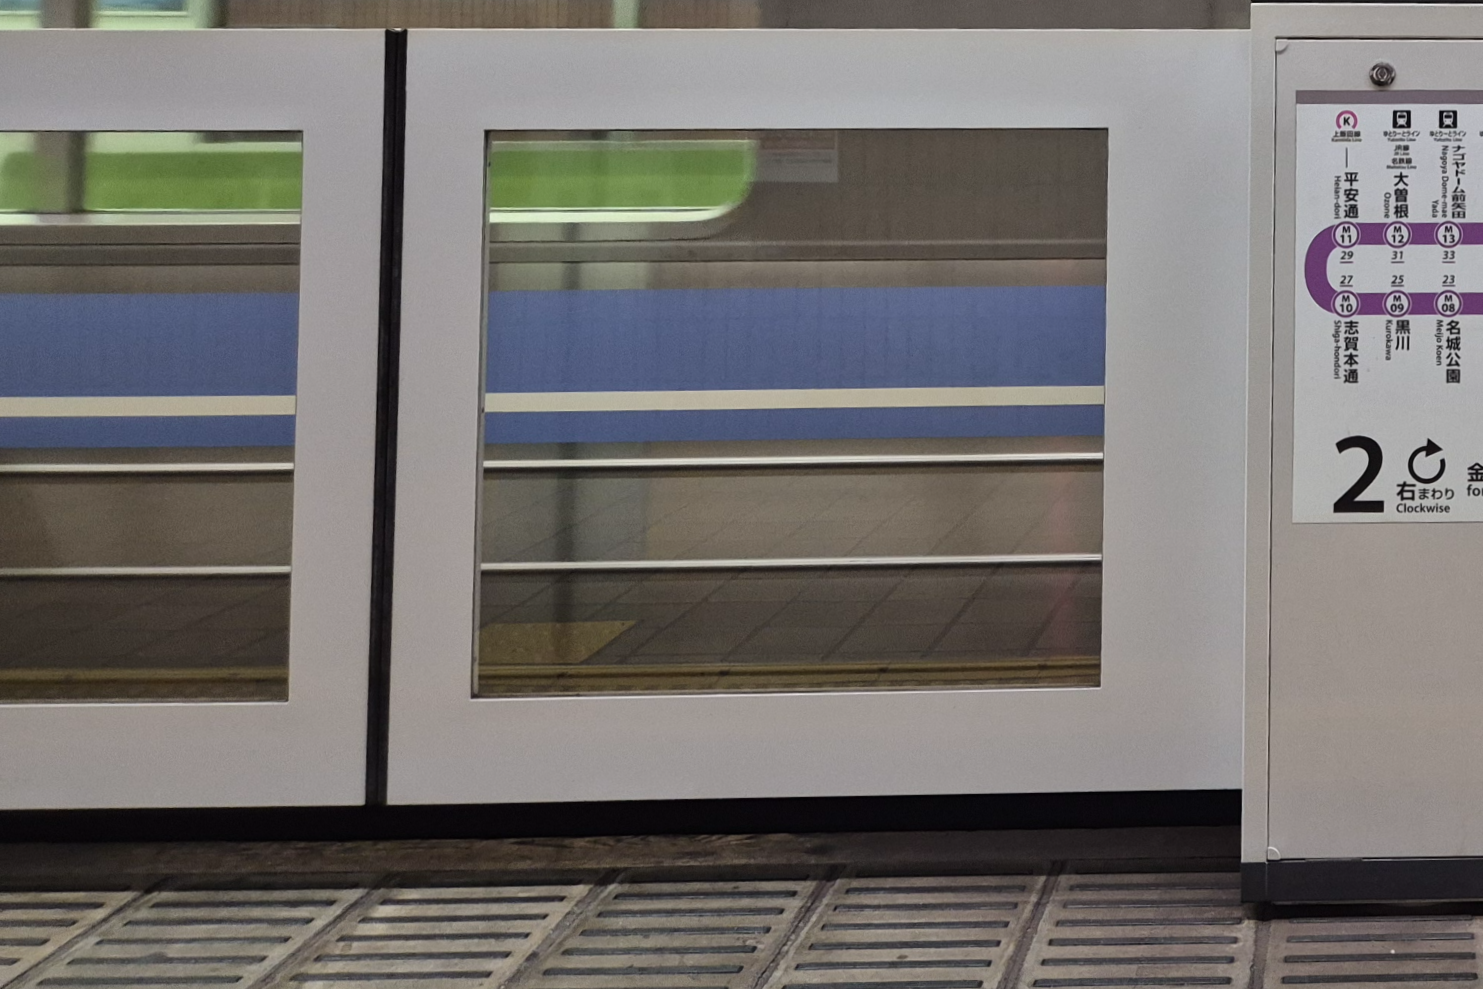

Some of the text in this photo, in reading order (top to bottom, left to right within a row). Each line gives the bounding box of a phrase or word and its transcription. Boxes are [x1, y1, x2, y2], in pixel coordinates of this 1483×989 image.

[1343, 116, 1350, 126] K
[1440, 145, 1449, 174] Nagoya
[1452, 145, 1466, 219] ナゴヤドーム前矢田
[1344, 172, 1359, 219] 平安通
[1394, 172, 1409, 219] 大曽根
[1340, 251, 1353, 260] 29
[1391, 251, 1404, 260] 31
[1442, 251, 1456, 260] 33
[1340, 275, 1353, 284] 27
[1391, 275, 1404, 284] 25
[1442, 275, 1455, 284] 23
[1395, 320, 1410, 351] 黒川
[1434, 320, 1443, 343] Meijo
[1332, 320, 1341, 379] Shiga-hondori
[1343, 320, 1359, 384] 志賀本通
[1446, 320, 1461, 384] 名城公園
[1333, 436, 1384, 513] 2
[1396, 482, 1455, 501] 右まわり
[1396, 503, 1450, 513] Clockwise
